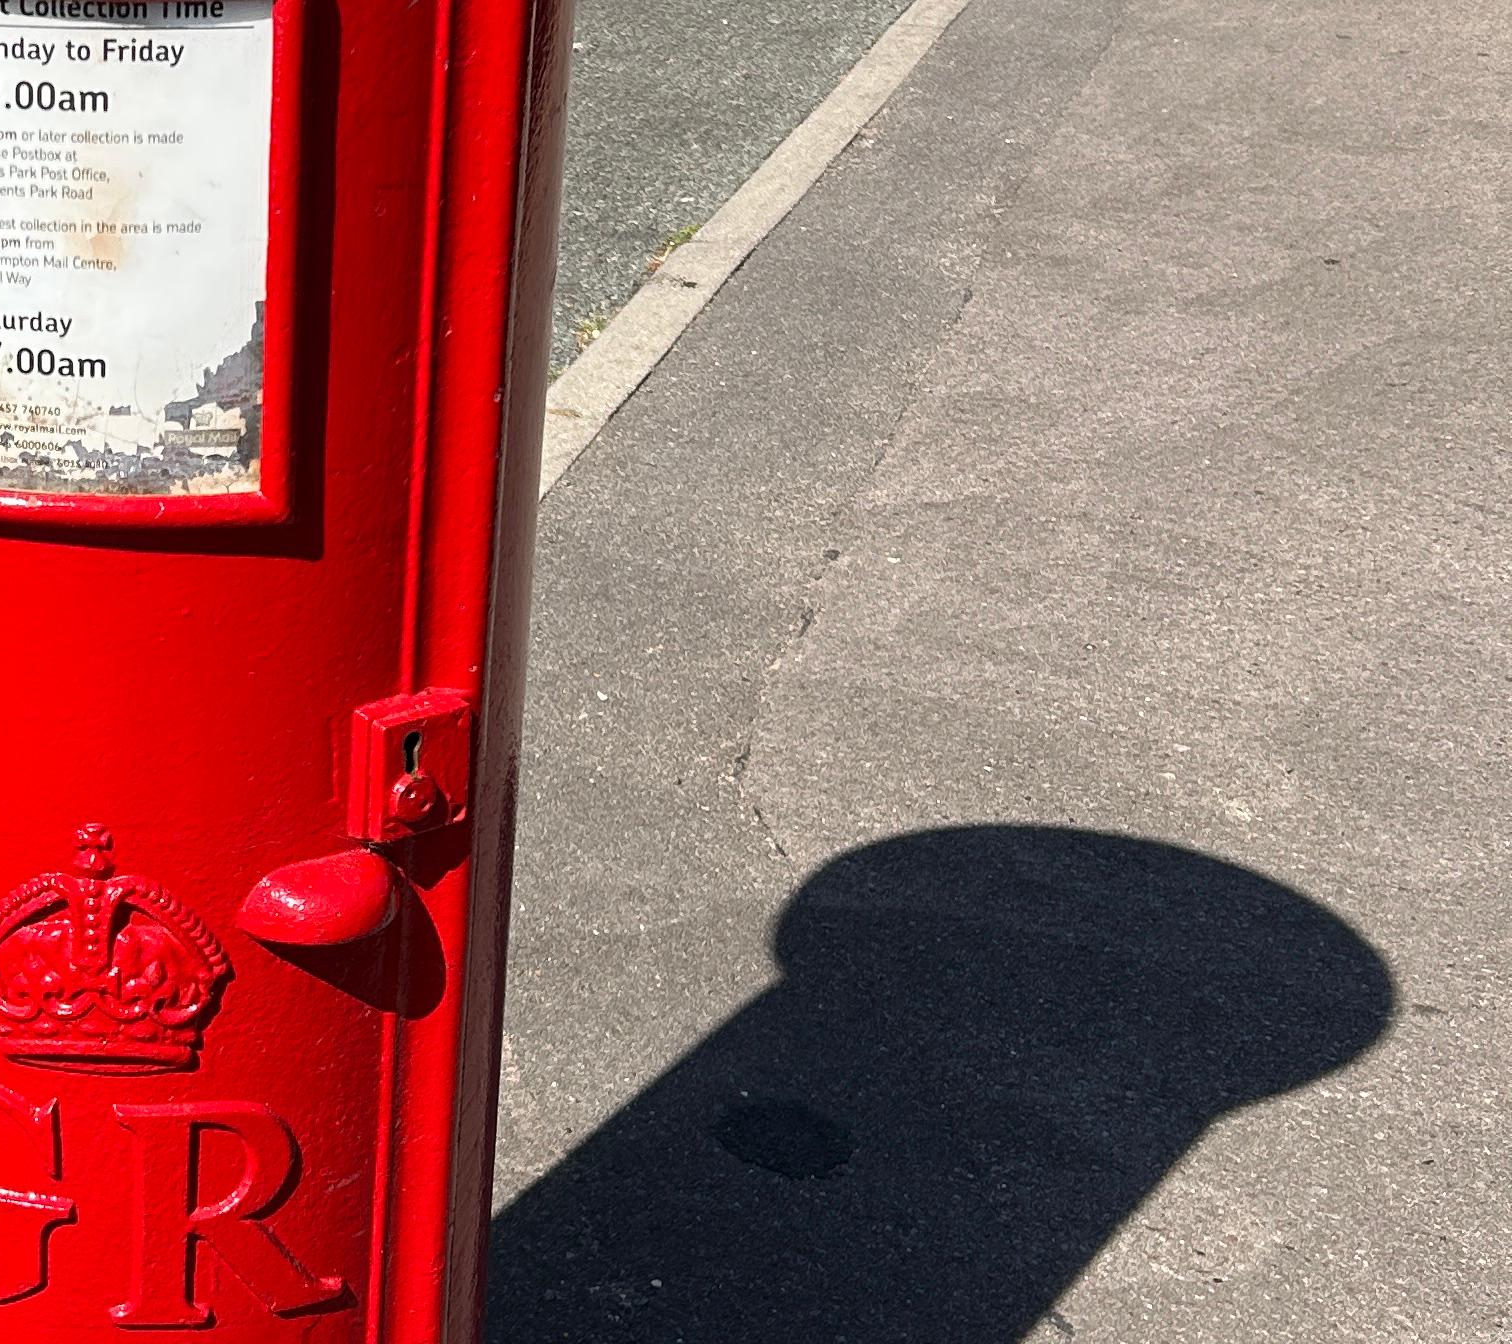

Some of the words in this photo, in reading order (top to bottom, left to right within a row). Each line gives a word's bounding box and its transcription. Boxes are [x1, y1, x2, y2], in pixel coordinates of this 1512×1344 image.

[65, 39, 91, 61] to
[103, 38, 185, 68] Friday
[21, 131, 35, 142] or
[38, 129, 67, 143] later
[71, 130, 129, 144] collection
[133, 130, 144, 145] is
[148, 131, 184, 145] made
[12, 146, 62, 162] Postbox
[65, 149, 78, 162] at
[9, 164, 37, 179] Park
[41, 166, 68, 181] Post
[71, 167, 110, 184] Office,
[30, 183, 58, 198] Park
[62, 185, 93, 200] Road
[20, 218, 76, 233] collection
[81, 219, 92, 233] in
[96, 221, 117, 234] the
[120, 222, 148, 234] area
[152, 220, 162, 234] is
[166, 220, 202, 234] made
[25, 236, 55, 250] from
[43, 255, 68, 269] Mail
[72, 256, 117, 272] Centre,
[6, 271, 32, 288] Way
[21, 403, 61, 416] 740740
